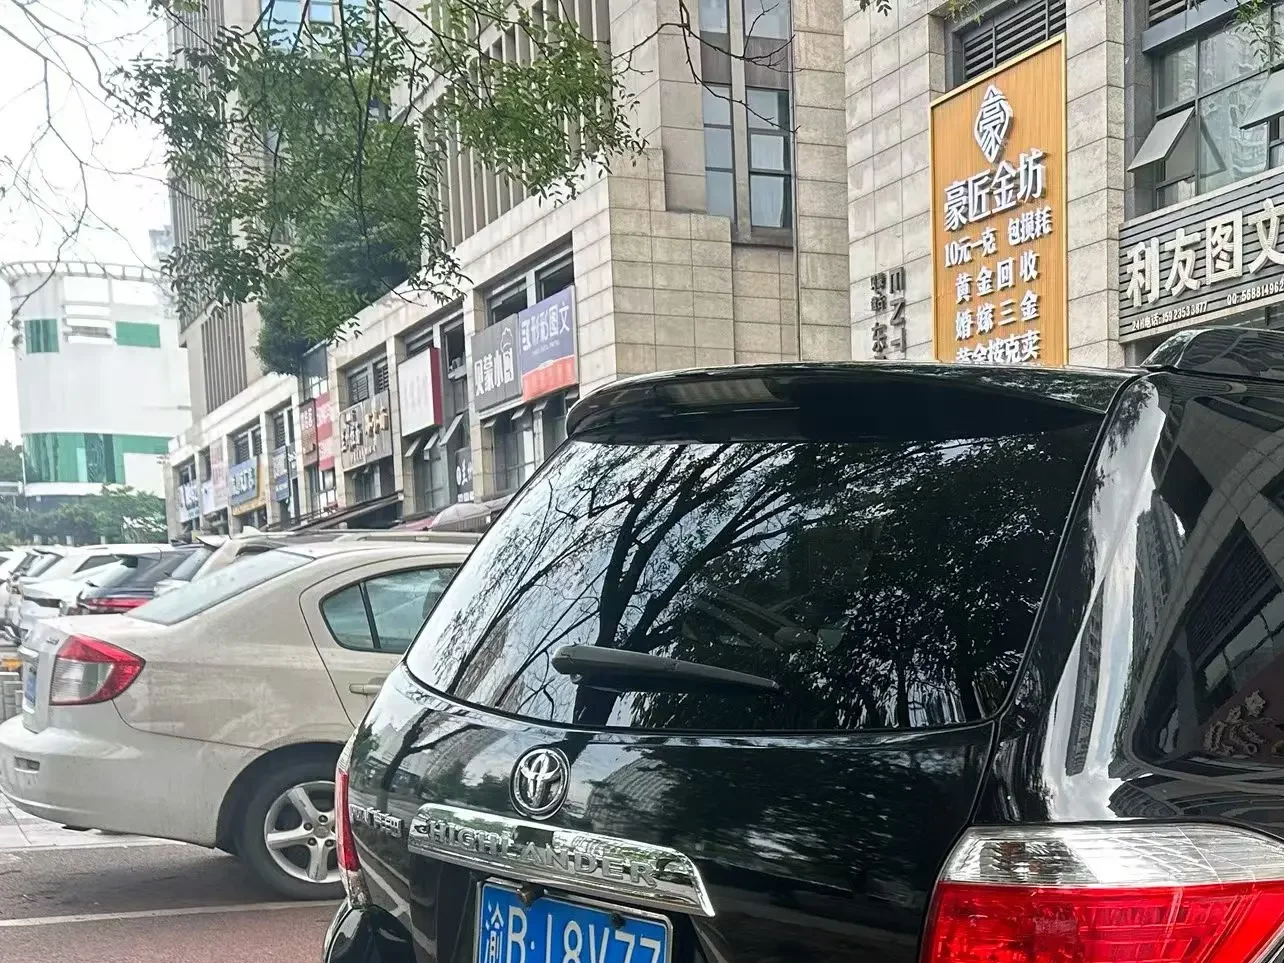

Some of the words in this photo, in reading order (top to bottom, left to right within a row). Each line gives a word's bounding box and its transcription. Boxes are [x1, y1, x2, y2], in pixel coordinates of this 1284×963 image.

[944, 147, 1046, 231] 豪匠金坊
[944, 227, 998, 267] 10元一克
[955, 250, 1040, 304] 黄金回收
[955, 289, 1040, 341] 婚嫁三金
[428, 819, 658, 887] HIGHLANDER
